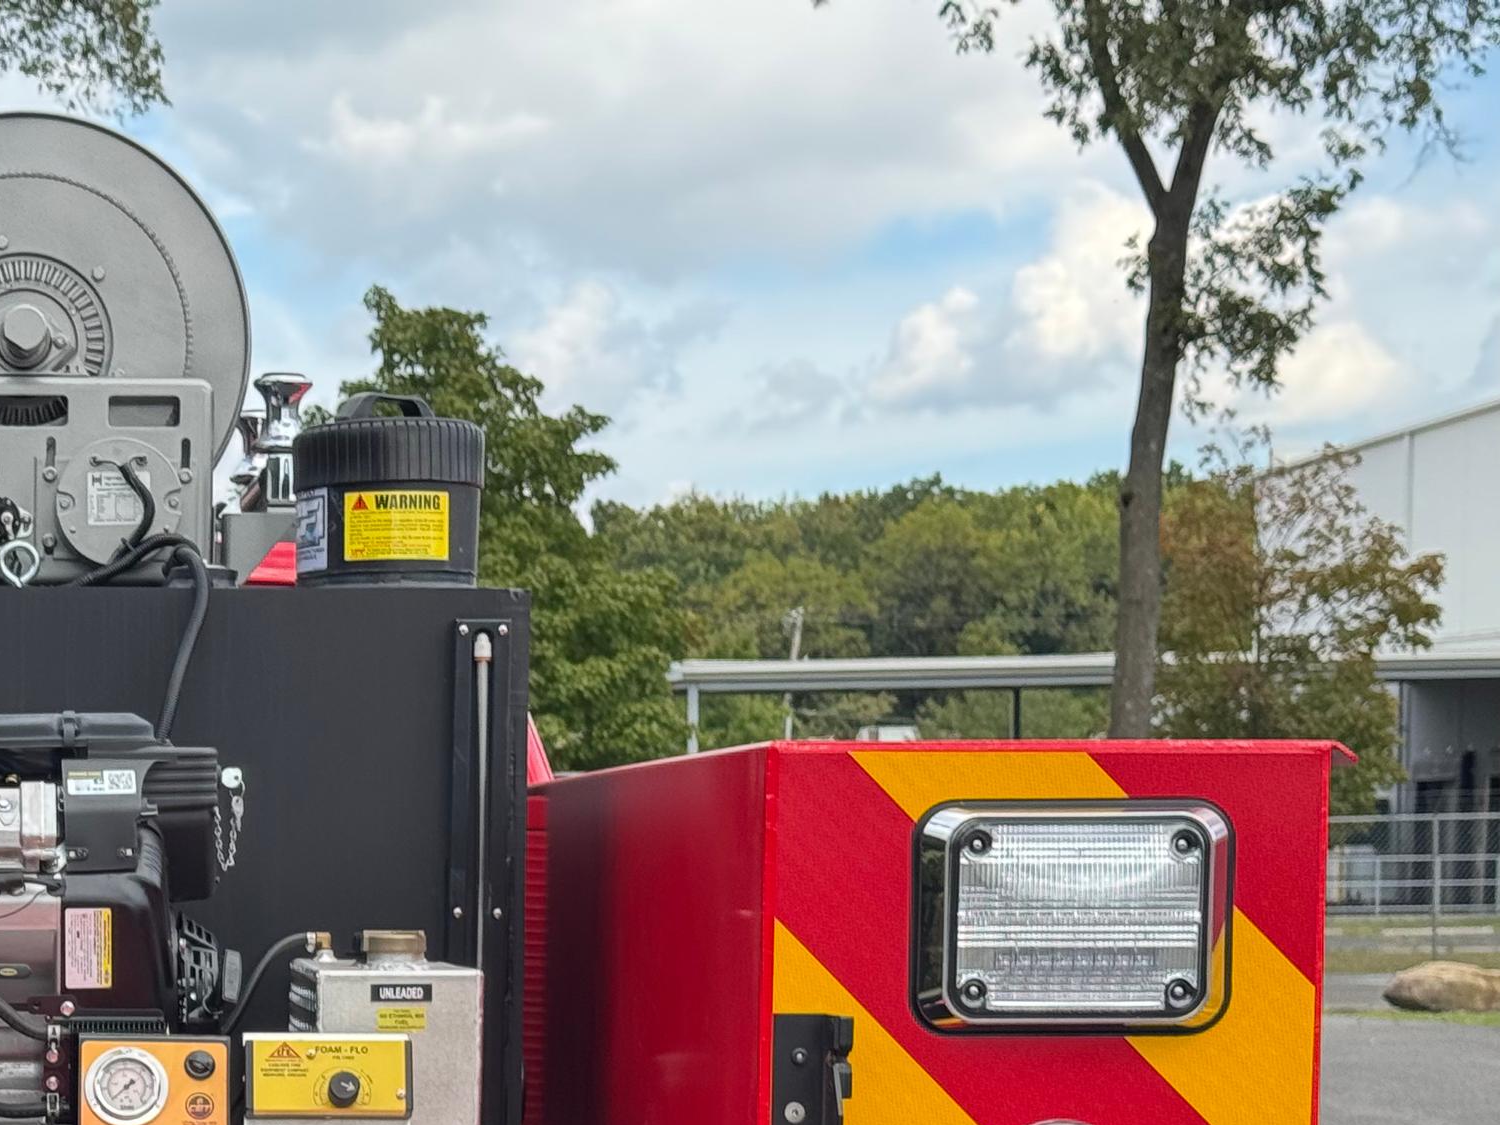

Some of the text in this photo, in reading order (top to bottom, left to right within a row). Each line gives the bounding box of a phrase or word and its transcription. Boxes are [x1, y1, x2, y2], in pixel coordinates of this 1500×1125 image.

[374, 494, 441, 510] WARNING
[379, 986, 424, 999] UNLEADED
[315, 1045, 342, 1054] FOAM
[350, 1046, 369, 1055] FLO
